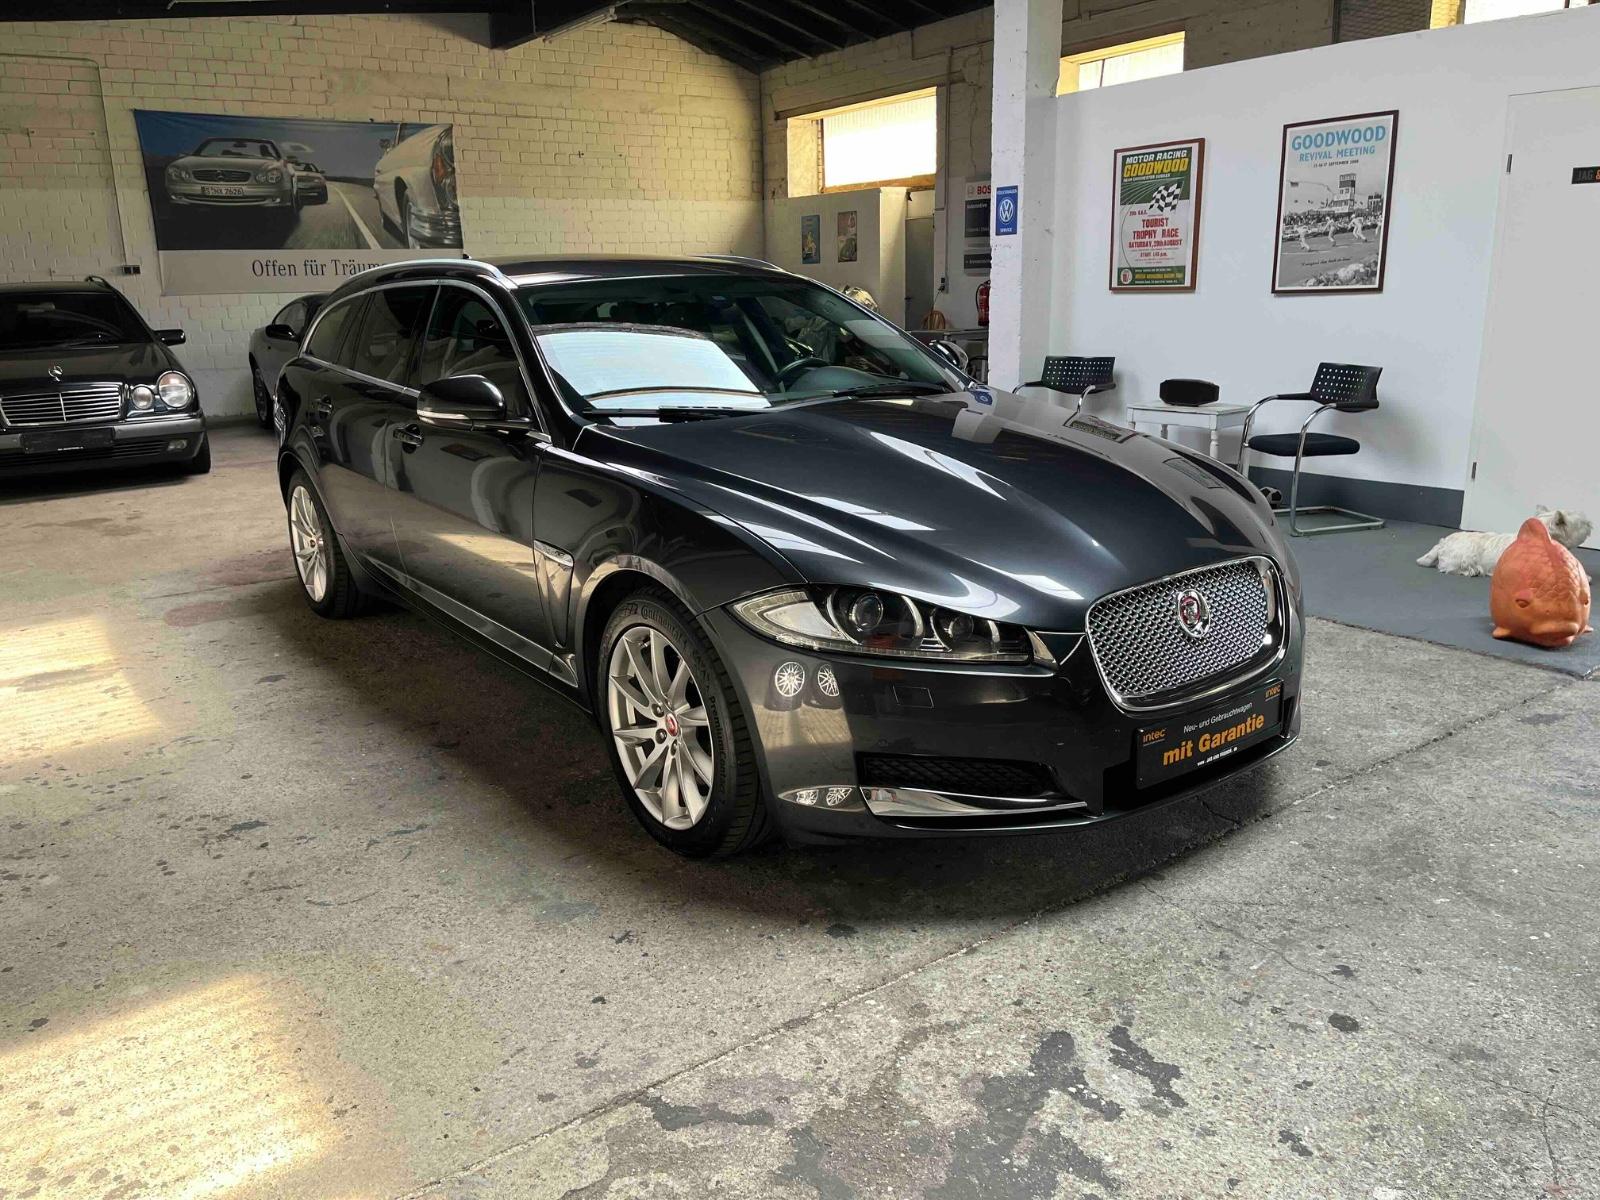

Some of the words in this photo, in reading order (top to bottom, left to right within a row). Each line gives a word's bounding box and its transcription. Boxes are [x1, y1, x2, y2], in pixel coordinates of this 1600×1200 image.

[1291, 125, 1386, 151] GOODWOOD
[1126, 153, 1155, 164] MOTOR
[1156, 150, 1187, 161] RACING
[1299, 150, 1333, 162] REVIVAL
[1336, 145, 1376, 158] MEETING
[1123, 157, 1189, 178] GOODWOOD
[977, 184, 991, 195] BOS
[1142, 217, 1169, 228] TOURIST
[1133, 229, 1157, 240] TROPHY
[1161, 228, 1179, 238] RACE
[252, 259, 298, 277] Offen
[303, 259, 327, 276] für
[331, 259, 386, 276] Träum
[1265, 683, 1281, 698] intec
[1183, 722, 1199, 734] Neu-
[1199, 719, 1210, 728] und
[1210, 702, 1253, 726] Gebrauchtwagen
[1142, 728, 1166, 743] intec
[1163, 739, 1194, 766] mit
[1198, 713, 1265, 753] Garantie
